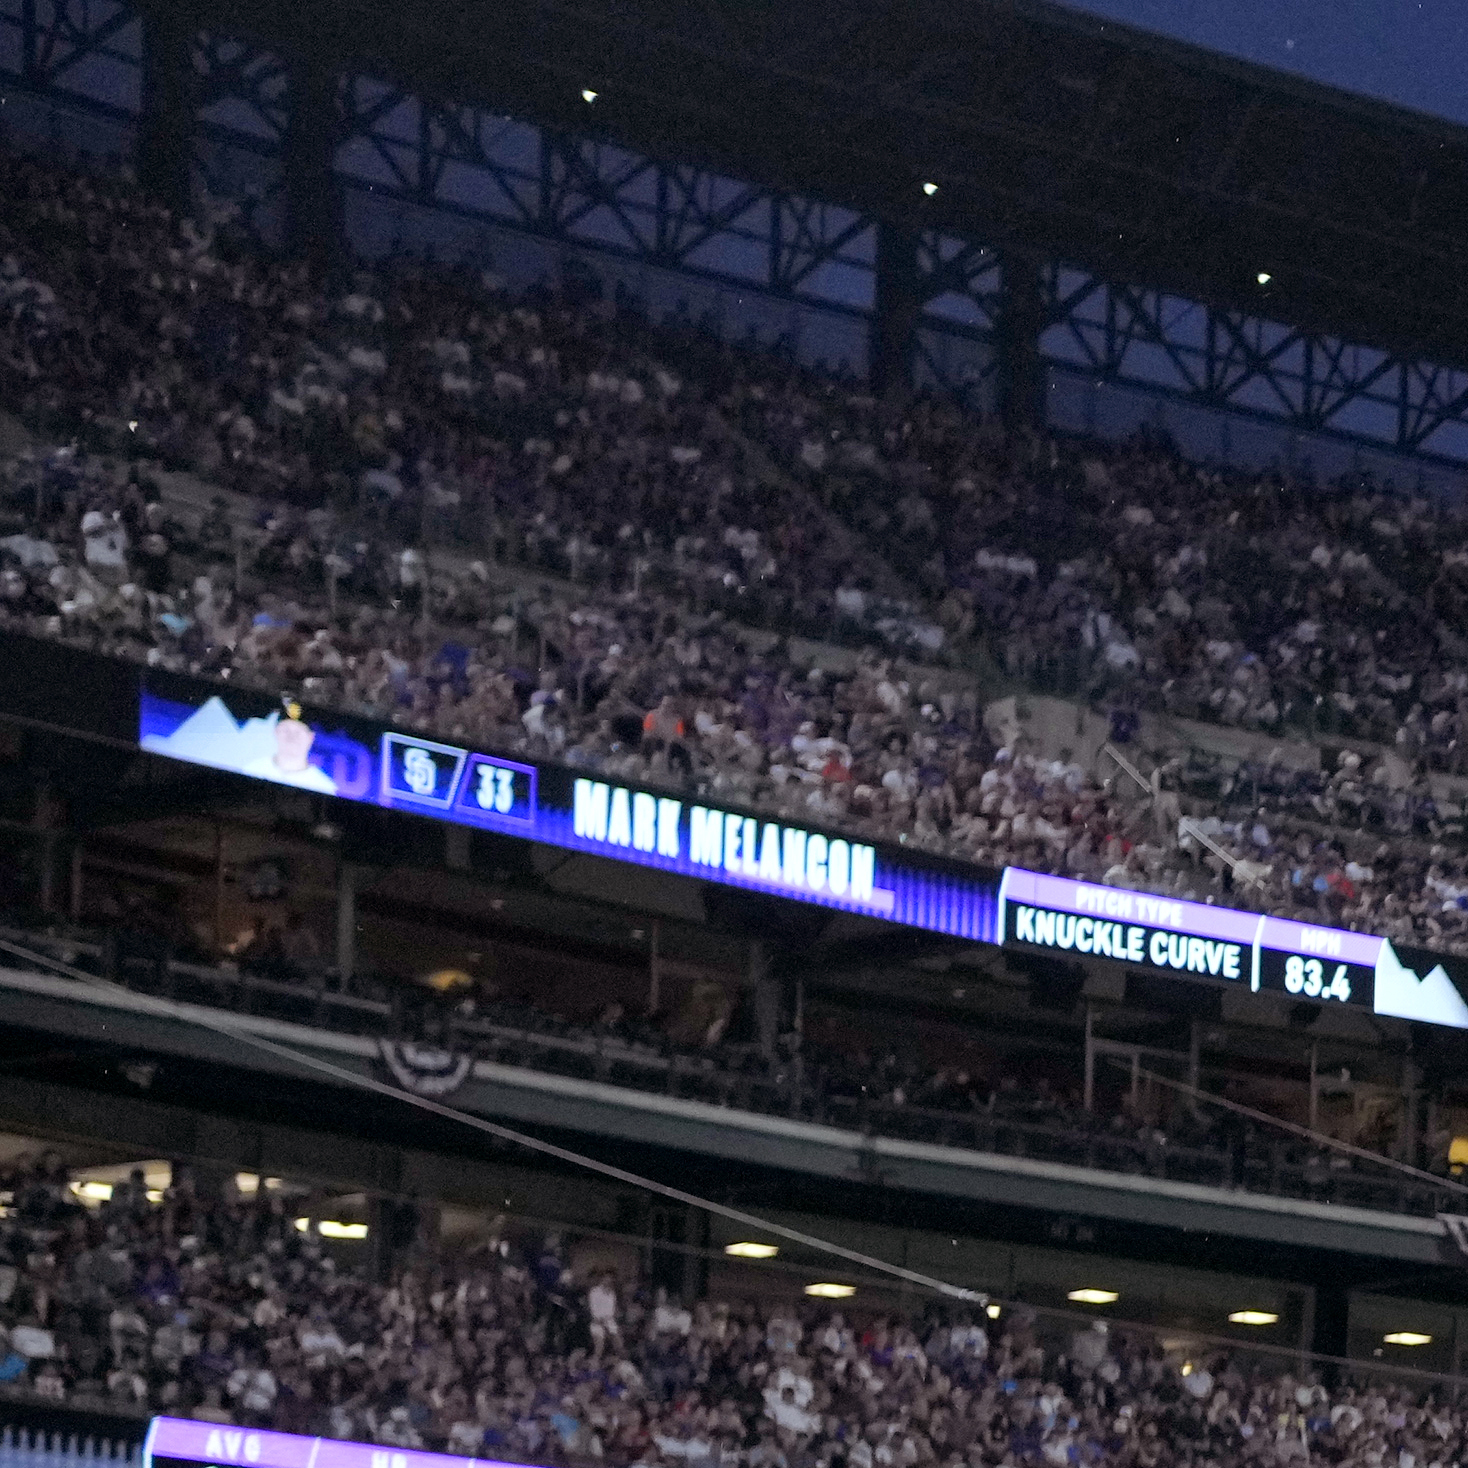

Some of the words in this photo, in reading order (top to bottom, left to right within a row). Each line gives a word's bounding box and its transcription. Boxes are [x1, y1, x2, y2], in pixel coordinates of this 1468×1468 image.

[475, 764, 514, 814] 33
[574, 778, 682, 858] MARK
[690, 805, 876, 901] MELANCON
[1075, 886, 1134, 915] PITCH
[1136, 896, 1184, 927] TYPE
[1016, 906, 1145, 962] KNUCKLE
[1150, 931, 1241, 979] CURVE
[1300, 928, 1342, 955] MPH
[1284, 955, 1351, 1002] 83.4
[206, 1429, 261, 1463] AVG
